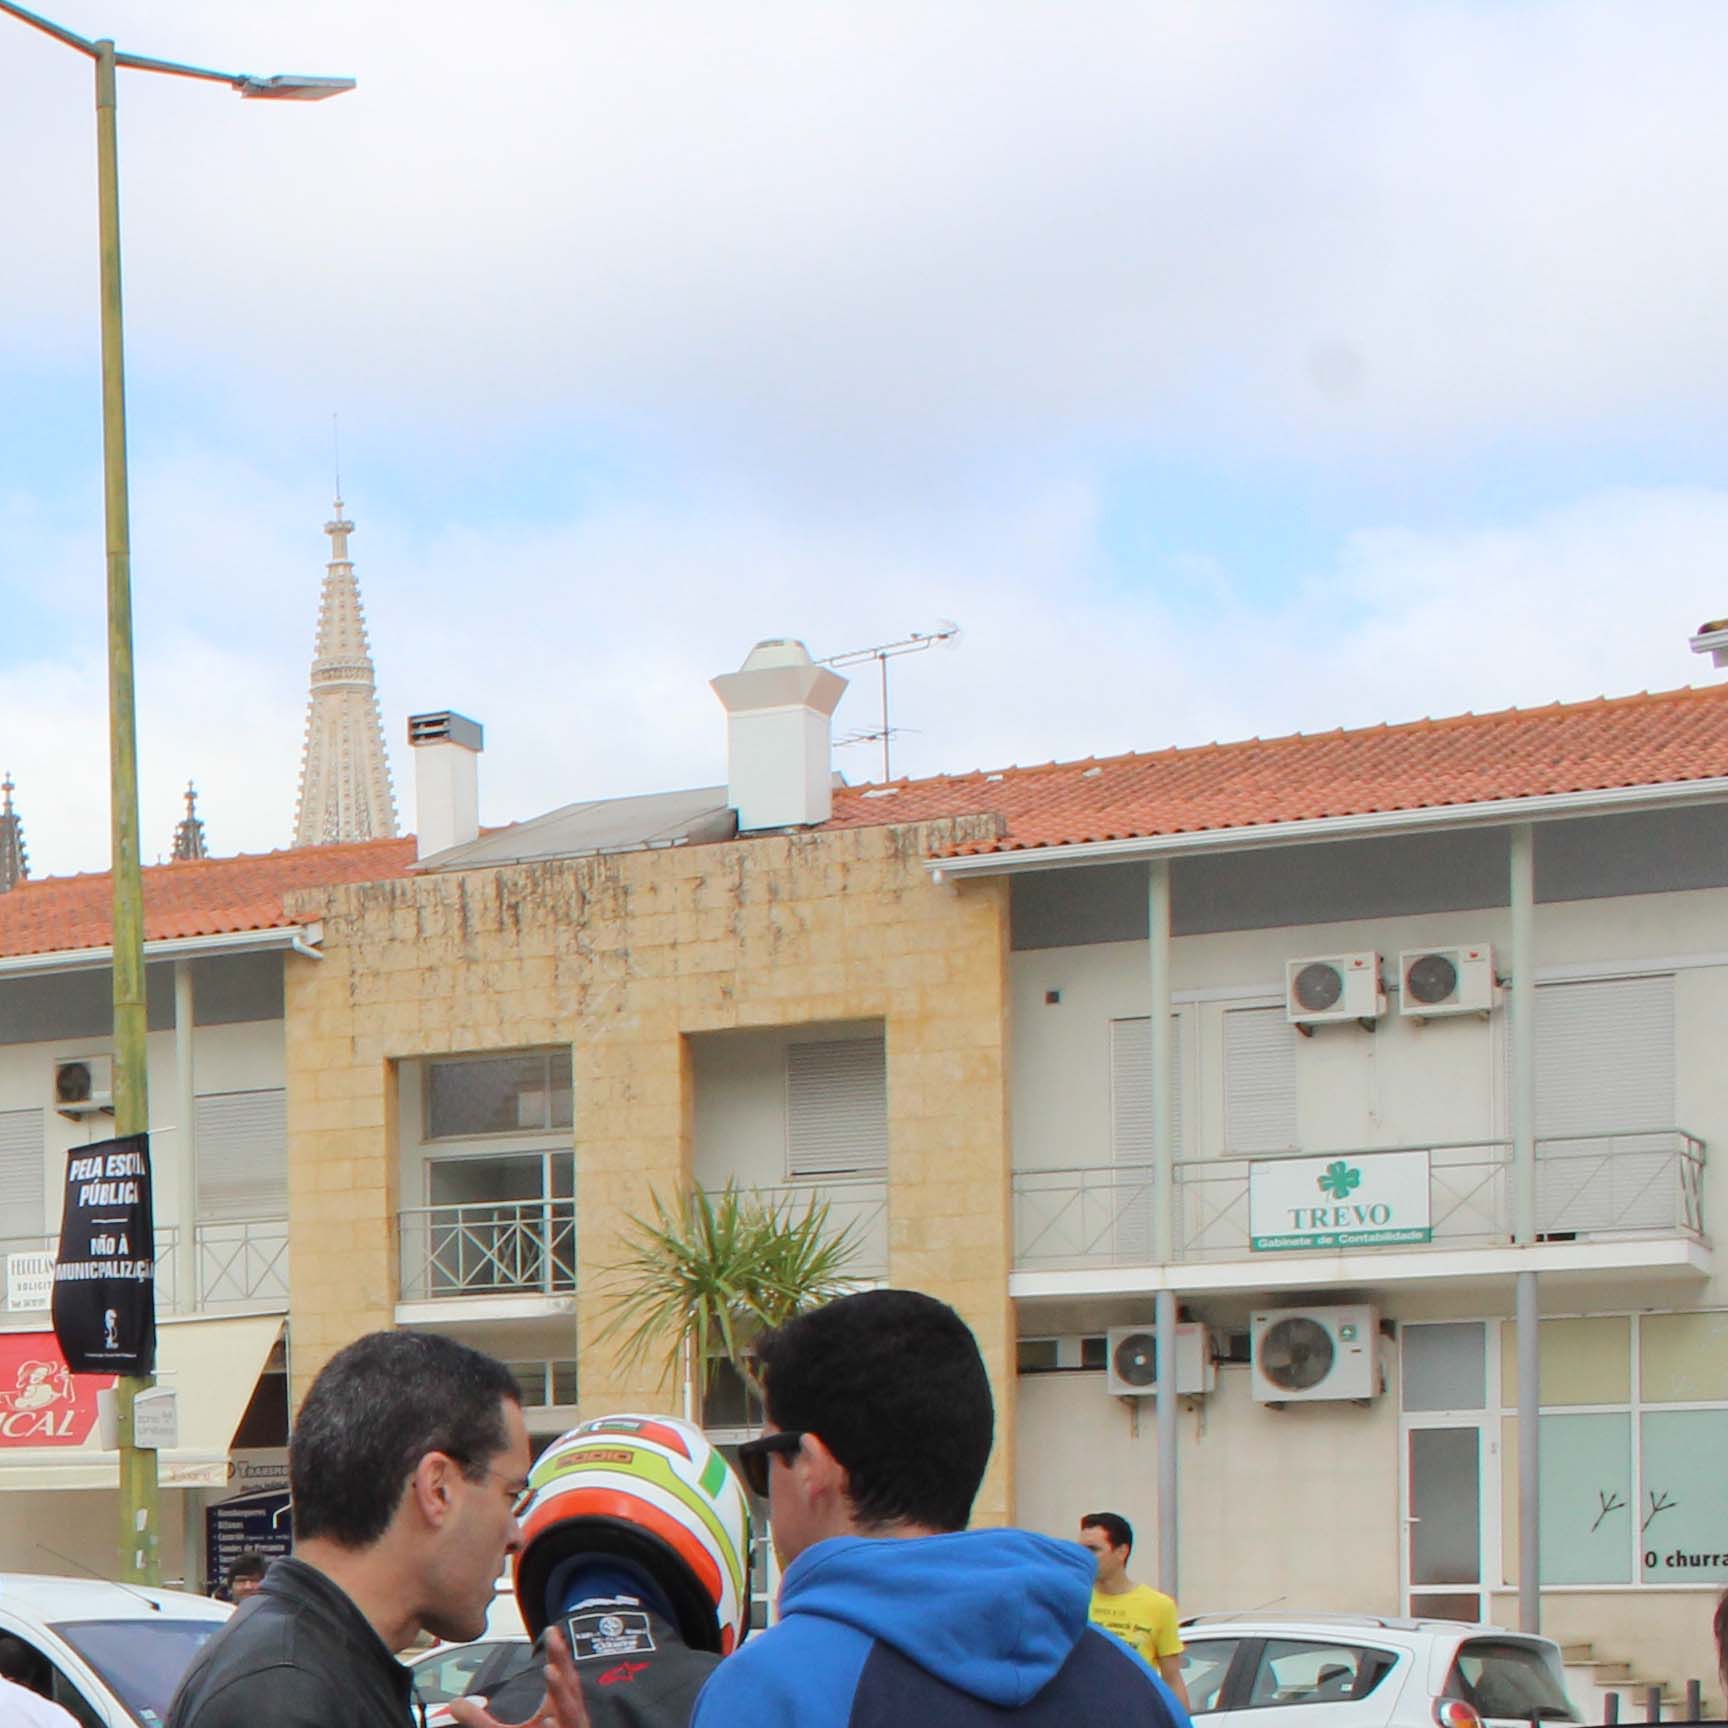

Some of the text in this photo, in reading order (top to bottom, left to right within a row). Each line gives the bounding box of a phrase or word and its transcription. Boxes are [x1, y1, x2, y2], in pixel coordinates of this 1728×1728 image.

[69, 1156, 102, 1182] PELA
[1288, 1203, 1391, 1230] TREVO
[90, 1233, 115, 1255] NÃO
[1258, 1230, 1424, 1248] Gabinete de Contabilidade
